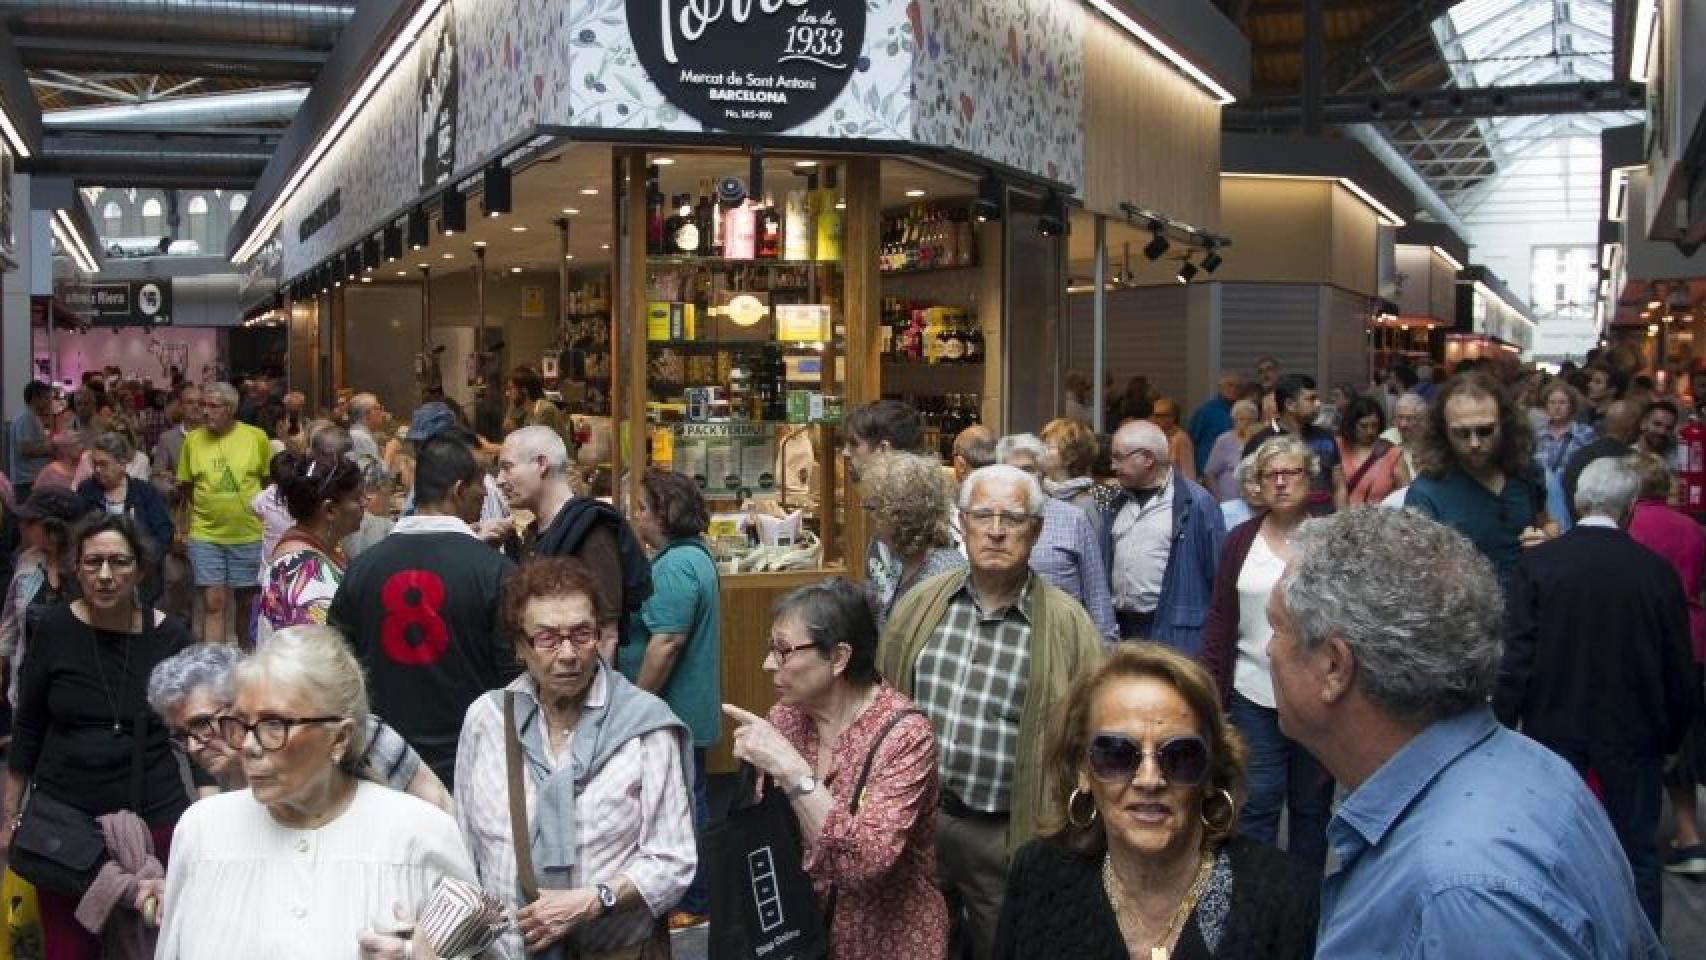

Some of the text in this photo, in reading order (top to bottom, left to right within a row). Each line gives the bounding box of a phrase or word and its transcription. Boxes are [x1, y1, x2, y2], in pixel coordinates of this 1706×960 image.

[784, 25, 844, 56] 1933
[679, 69, 817, 90] Mercat de Sant Antoni
[709, 87, 788, 103] BARCELONA
[686, 424, 718, 437] PACK
[381, 569, 449, 665] 8
